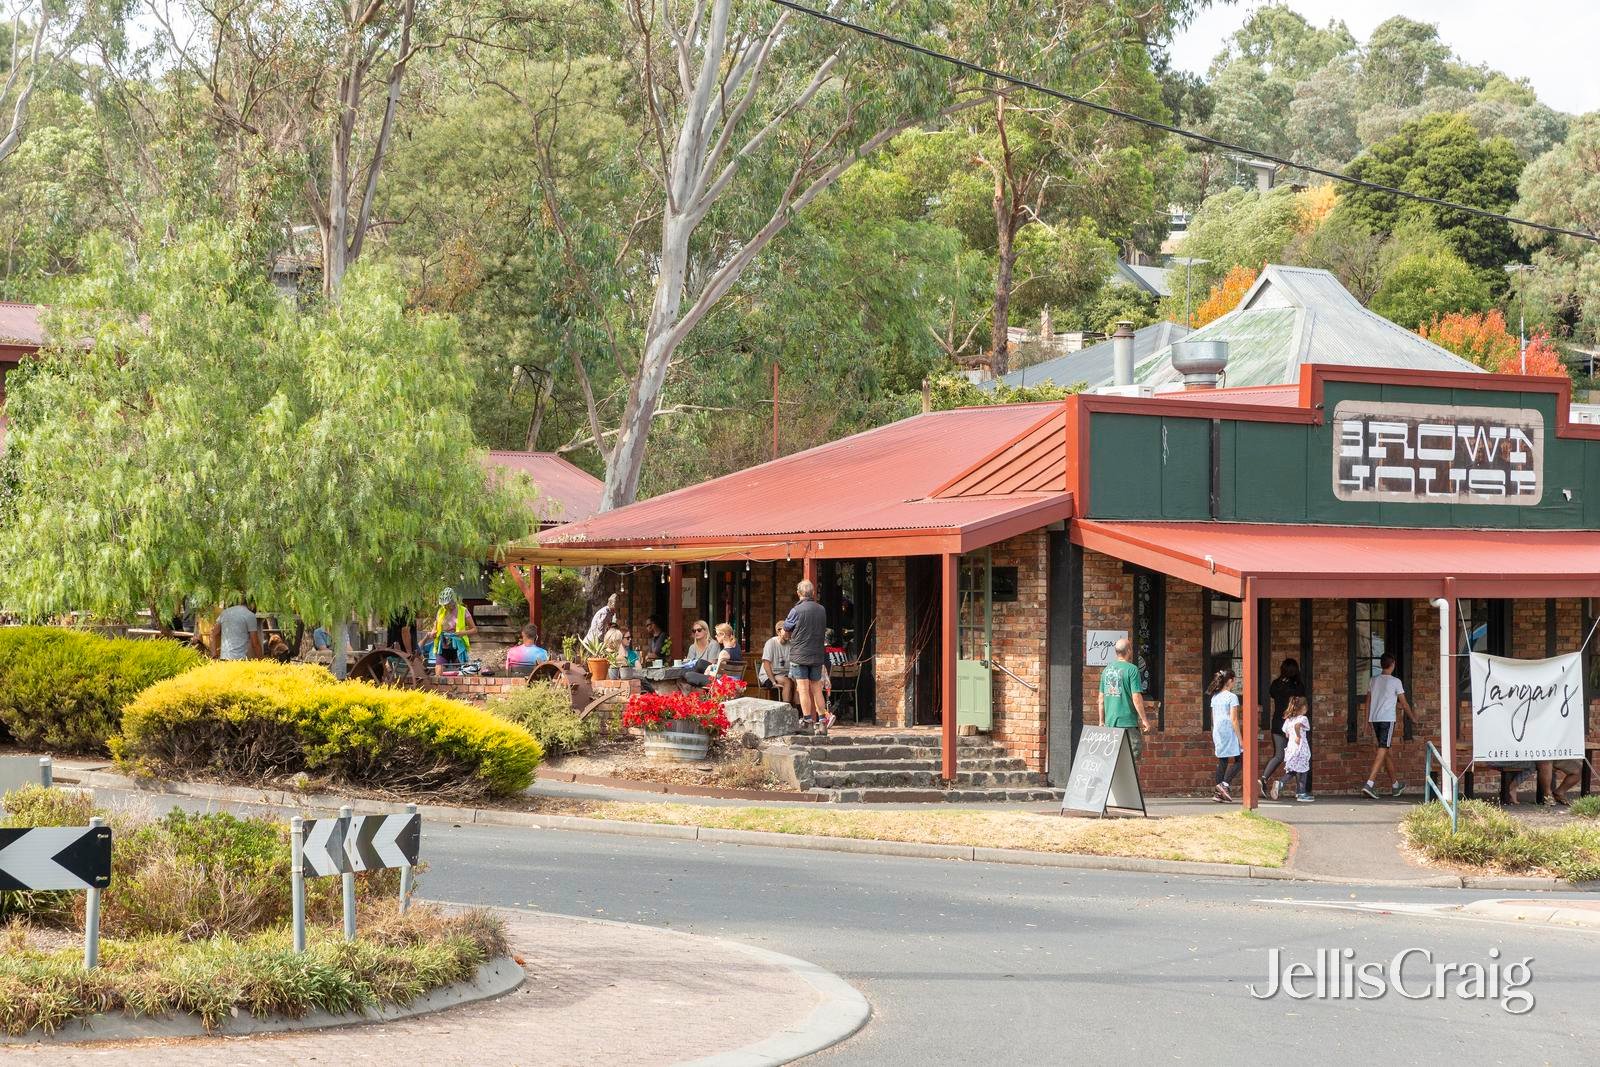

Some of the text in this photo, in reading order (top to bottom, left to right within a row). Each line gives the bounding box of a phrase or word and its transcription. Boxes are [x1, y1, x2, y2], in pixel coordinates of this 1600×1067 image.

[1477, 658, 1579, 742] Langan's
[1488, 749, 1573, 758] CAFE & FOODSTORE
